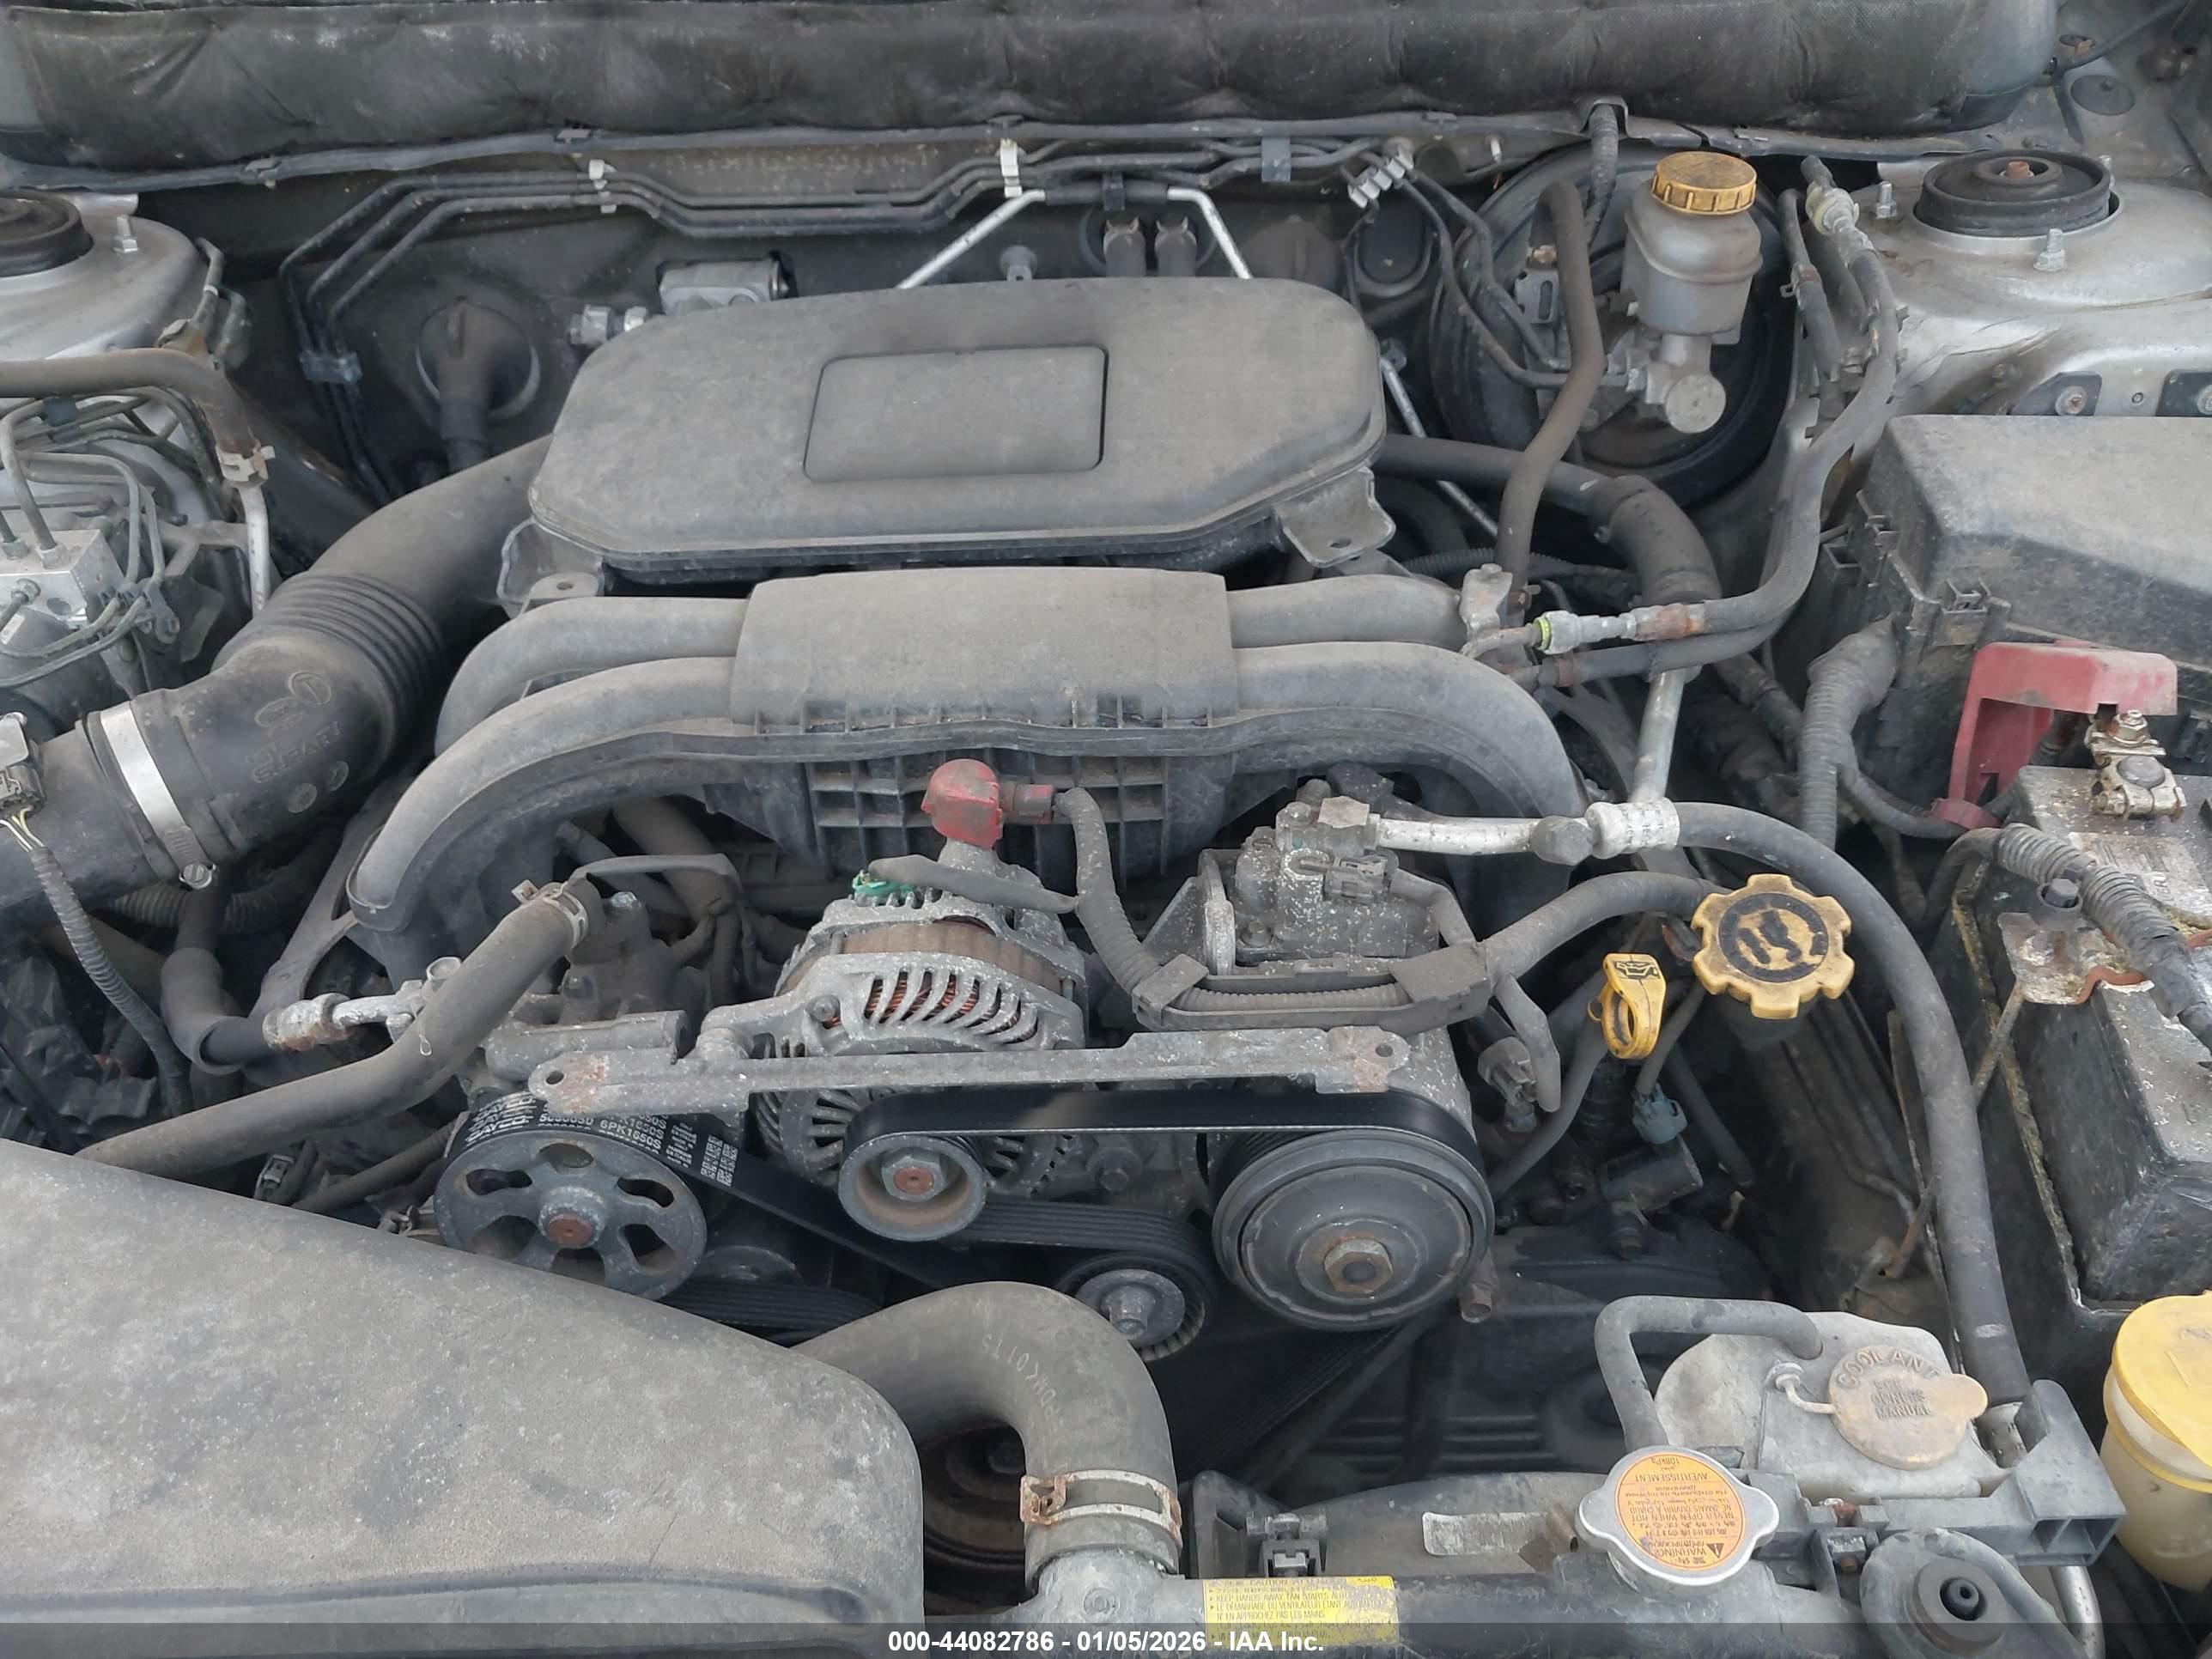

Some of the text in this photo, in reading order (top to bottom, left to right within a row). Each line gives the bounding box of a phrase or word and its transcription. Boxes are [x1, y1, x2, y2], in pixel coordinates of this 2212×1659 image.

[600, 1120, 662, 1150] 6PK1650S
[1836, 1348, 1941, 1389] COOLANT
[1635, 1473, 1708, 1483] AVERTISSEMENT
[1632, 1515, 1649, 1523] HOT
[1651, 1514, 1678, 1522] WHEN
[1680, 1512, 1704, 1522] OPEN
[1656, 1548, 1707, 1558] WARNING
